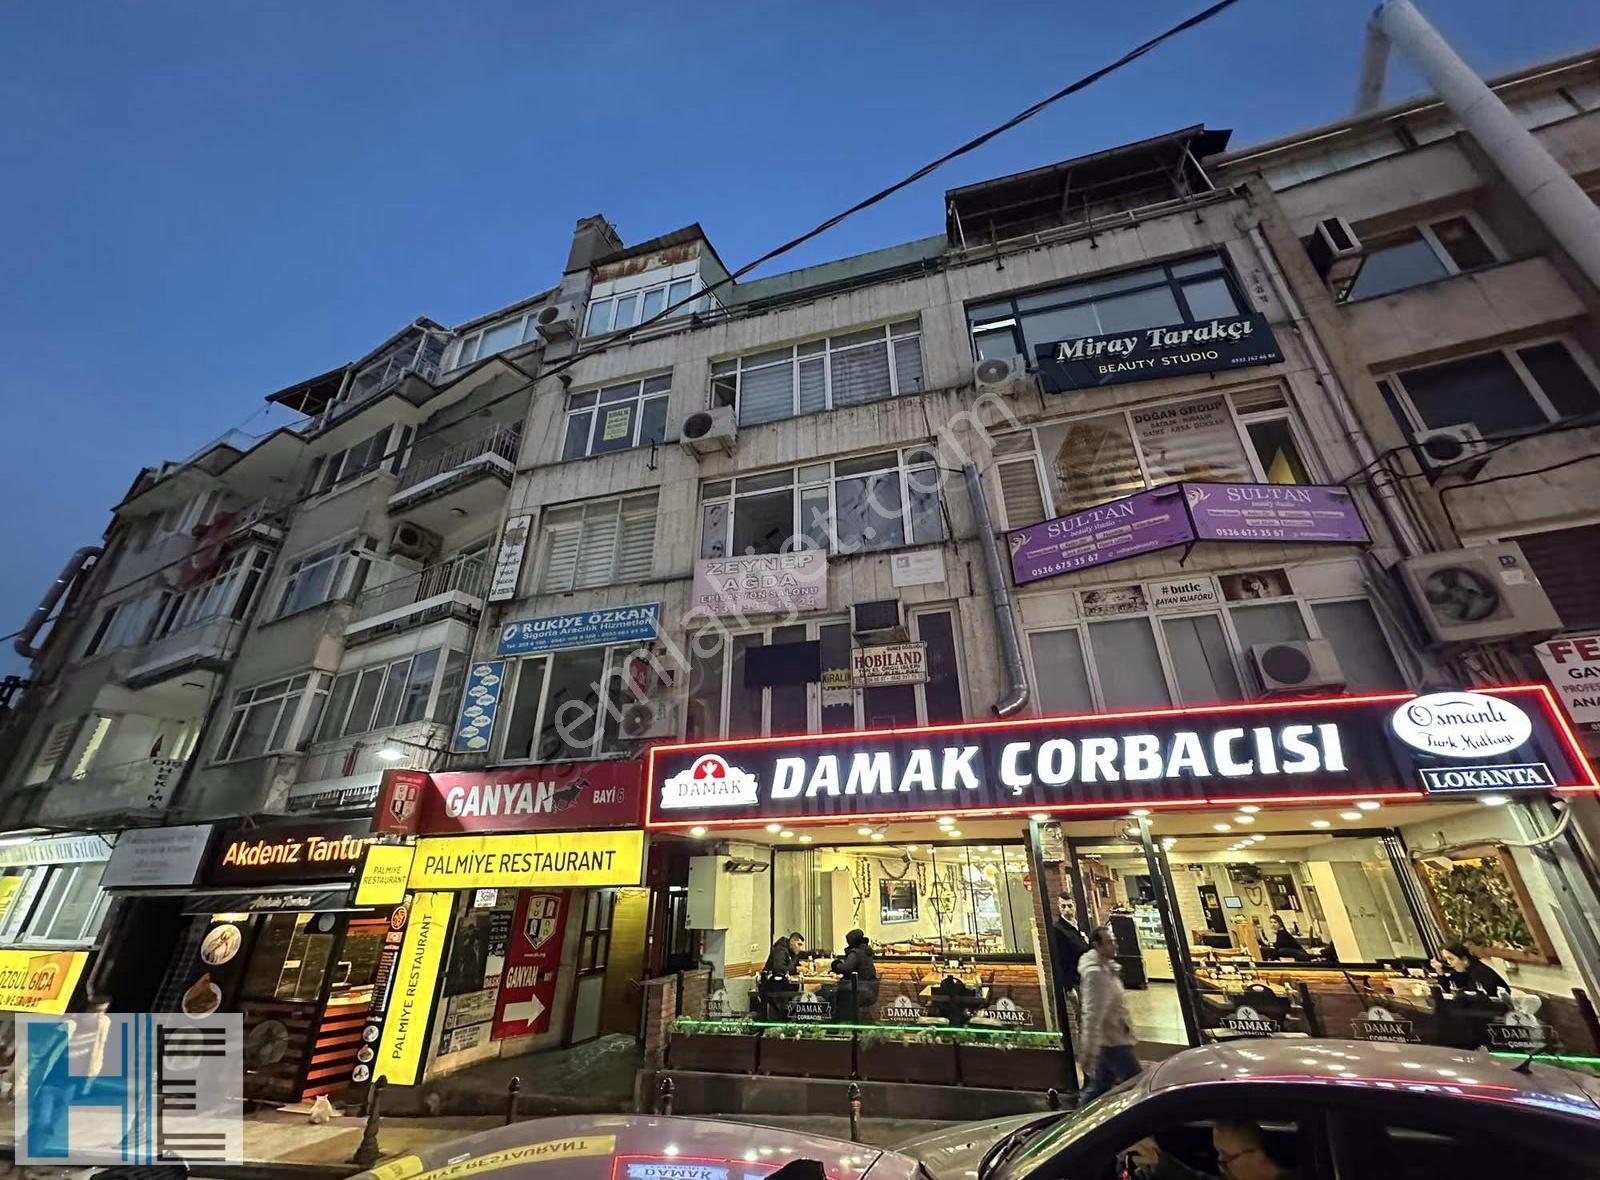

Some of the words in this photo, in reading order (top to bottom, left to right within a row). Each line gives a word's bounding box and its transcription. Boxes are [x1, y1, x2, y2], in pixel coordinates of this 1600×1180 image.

[1056, 336, 1138, 360] Miray
[1147, 320, 1253, 348] Tarakçı
[1099, 358, 1154, 374] BEAUTY
[1162, 351, 1218, 366] STUDIO
[1180, 402, 1222, 416] GROUP
[1227, 487, 1312, 503] SULTAN
[1048, 501, 1135, 538] SULTAN
[1216, 528, 1239, 537] 0536
[1241, 529, 1258, 537] 675
[1260, 529, 1272, 537] 35
[1274, 529, 1284, 537] 67
[706, 555, 813, 575] ZEYNEP
[1032, 565, 1053, 576] 0536
[1056, 560, 1071, 571] 675
[1074, 556, 1085, 566] 35
[1088, 553, 1098, 562] 67
[722, 573, 798, 591] AĞDA
[769, 586, 818, 598] SALONU
[522, 616, 583, 633] RUKİYE
[589, 606, 655, 624] ÖZKAN
[855, 651, 922, 669] HOBİLAND
[1546, 638, 1600, 664] FE
[771, 746, 979, 799] DAMAK
[1000, 723, 1349, 796] ÇORBACISI
[1429, 768, 1545, 788] LOKANTA
[678, 780, 742, 797] DAMAK
[445, 781, 555, 818] GANYAN
[593, 785, 616, 803] BAYİ
[222, 838, 302, 866] Akdeniz
[424, 850, 497, 875] PALMİYE
[499, 850, 616, 873] RESTAURANT
[363, 875, 407, 884] RESTAURANT
[406, 913, 433, 997] RESTAURANT
[28, 971, 56, 991] GIDA
[506, 965, 539, 989] GANYAN
[796, 1004, 823, 1013] DAMAK
[887, 1008, 921, 1017] DAMAK
[989, 1011, 1025, 1021] DAMAK
[1228, 1020, 1272, 1032] DAMAK
[1364, 1023, 1405, 1035] DAMAK
